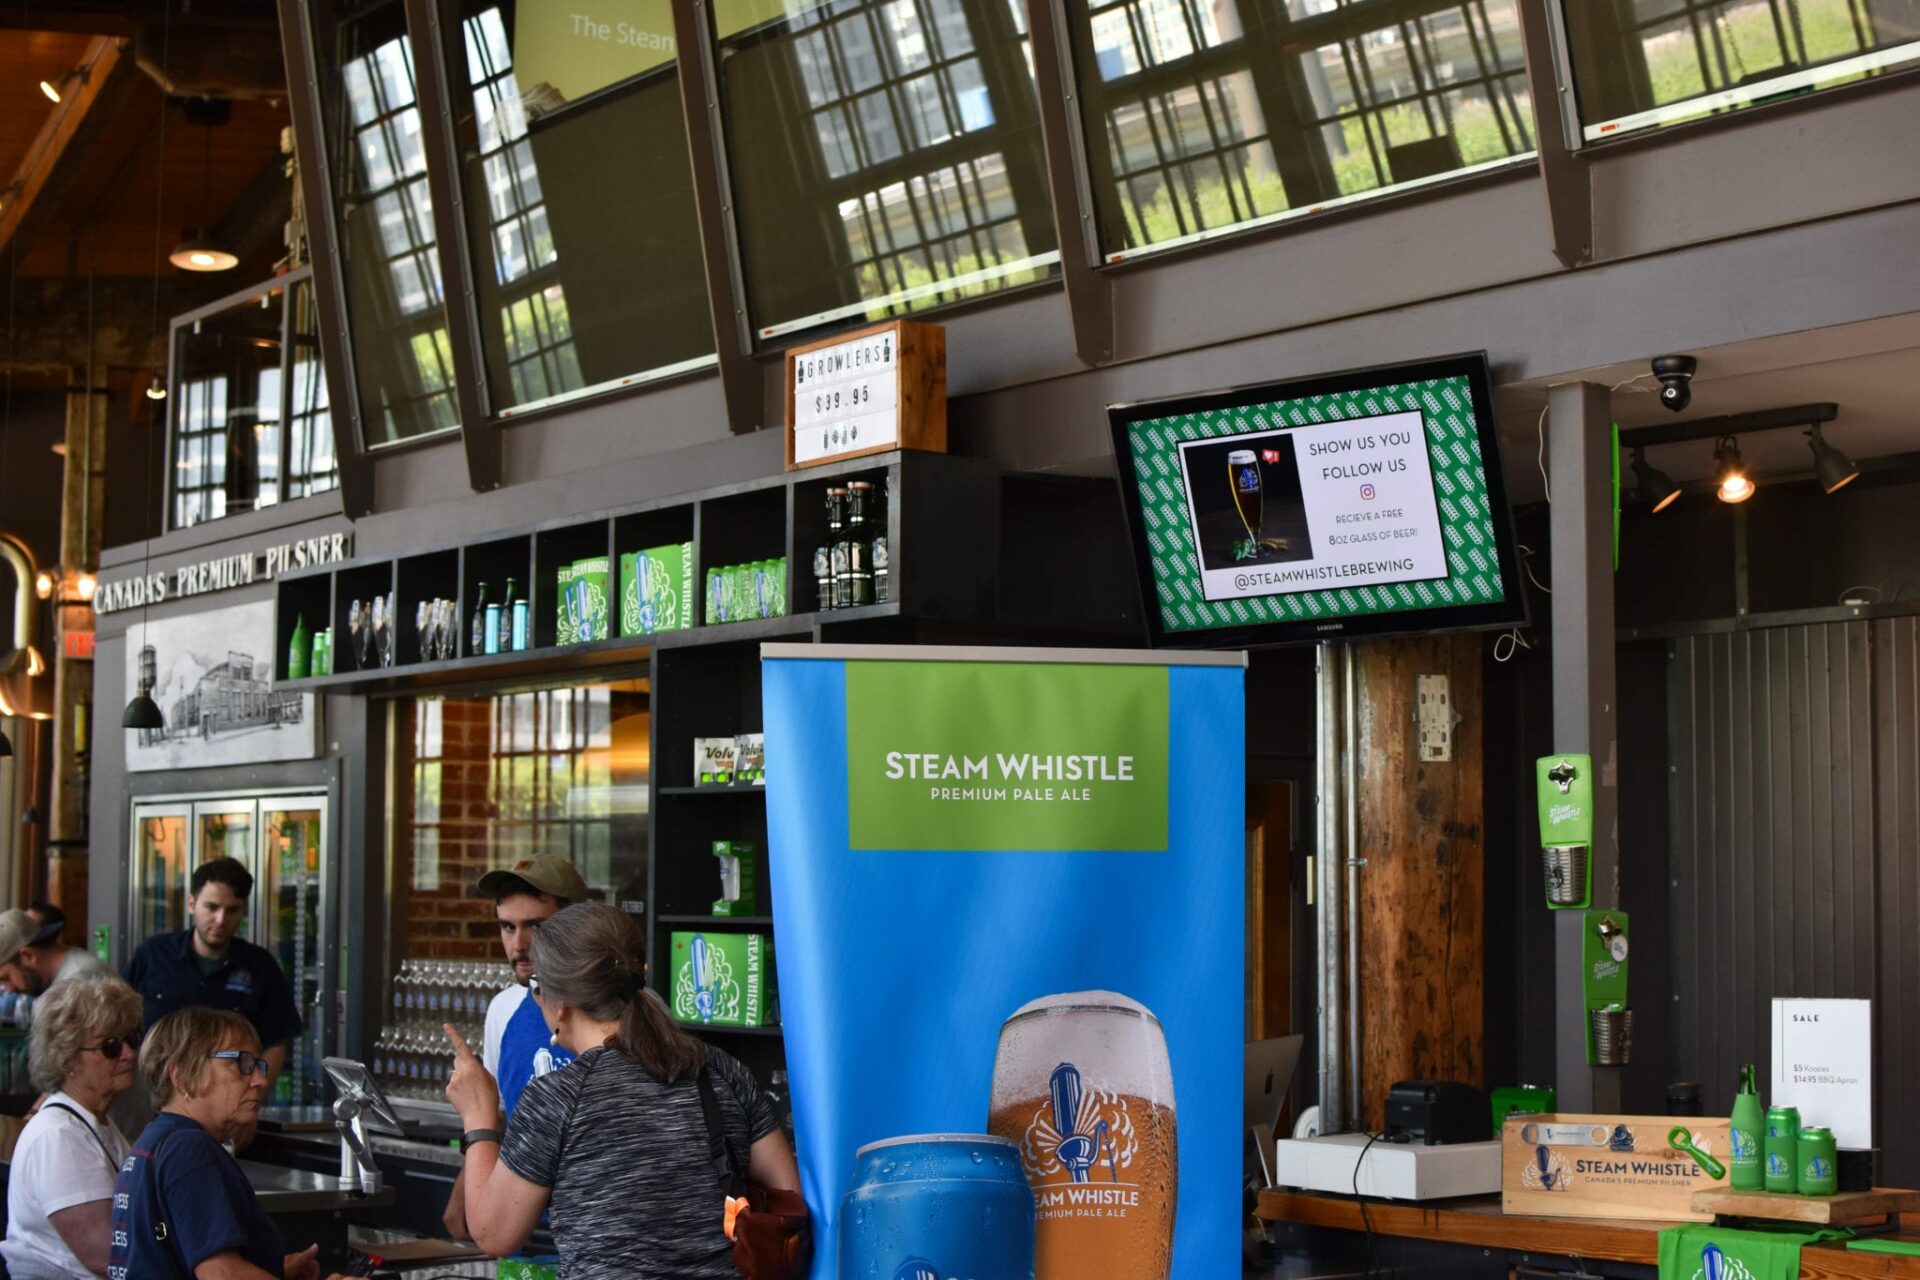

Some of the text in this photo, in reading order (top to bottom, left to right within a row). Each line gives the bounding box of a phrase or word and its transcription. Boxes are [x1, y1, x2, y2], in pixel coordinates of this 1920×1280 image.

[570, 14, 611, 41] The
[807, 345, 880, 378] GROWLERS
[815, 385, 869, 414] $39.95
[1309, 431, 1411, 456] SHOW US YOU
[1322, 459, 1407, 480] FOLLOW US
[1335, 508, 1404, 525] RECIEVE A FREE
[1349, 532, 1378, 543] GLASS
[1378, 530, 1391, 540] OF
[176, 552, 254, 598] PREMIUM
[265, 533, 345, 580] PILSNER
[1234, 558, 1415, 591] @STEAMWHISTLEBREWING
[885, 751, 1135, 781] STEAM WHISTLE
[931, 787, 1091, 800] PREMIUM PALE ALE
[745, 934, 759, 1027] STEAM WHISTLE
[1793, 1014, 1820, 1022] SALE
[1818, 1076, 1835, 1084] BBQ
[1836, 1076, 1858, 1085] Apron
[1576, 1159, 1701, 1177] STEAM WHISTLE
[1034, 1188, 1139, 1208] EAM WHISTLE
[1077, 1208, 1103, 1217] PALE
[1106, 1209, 1127, 1217] ALE
